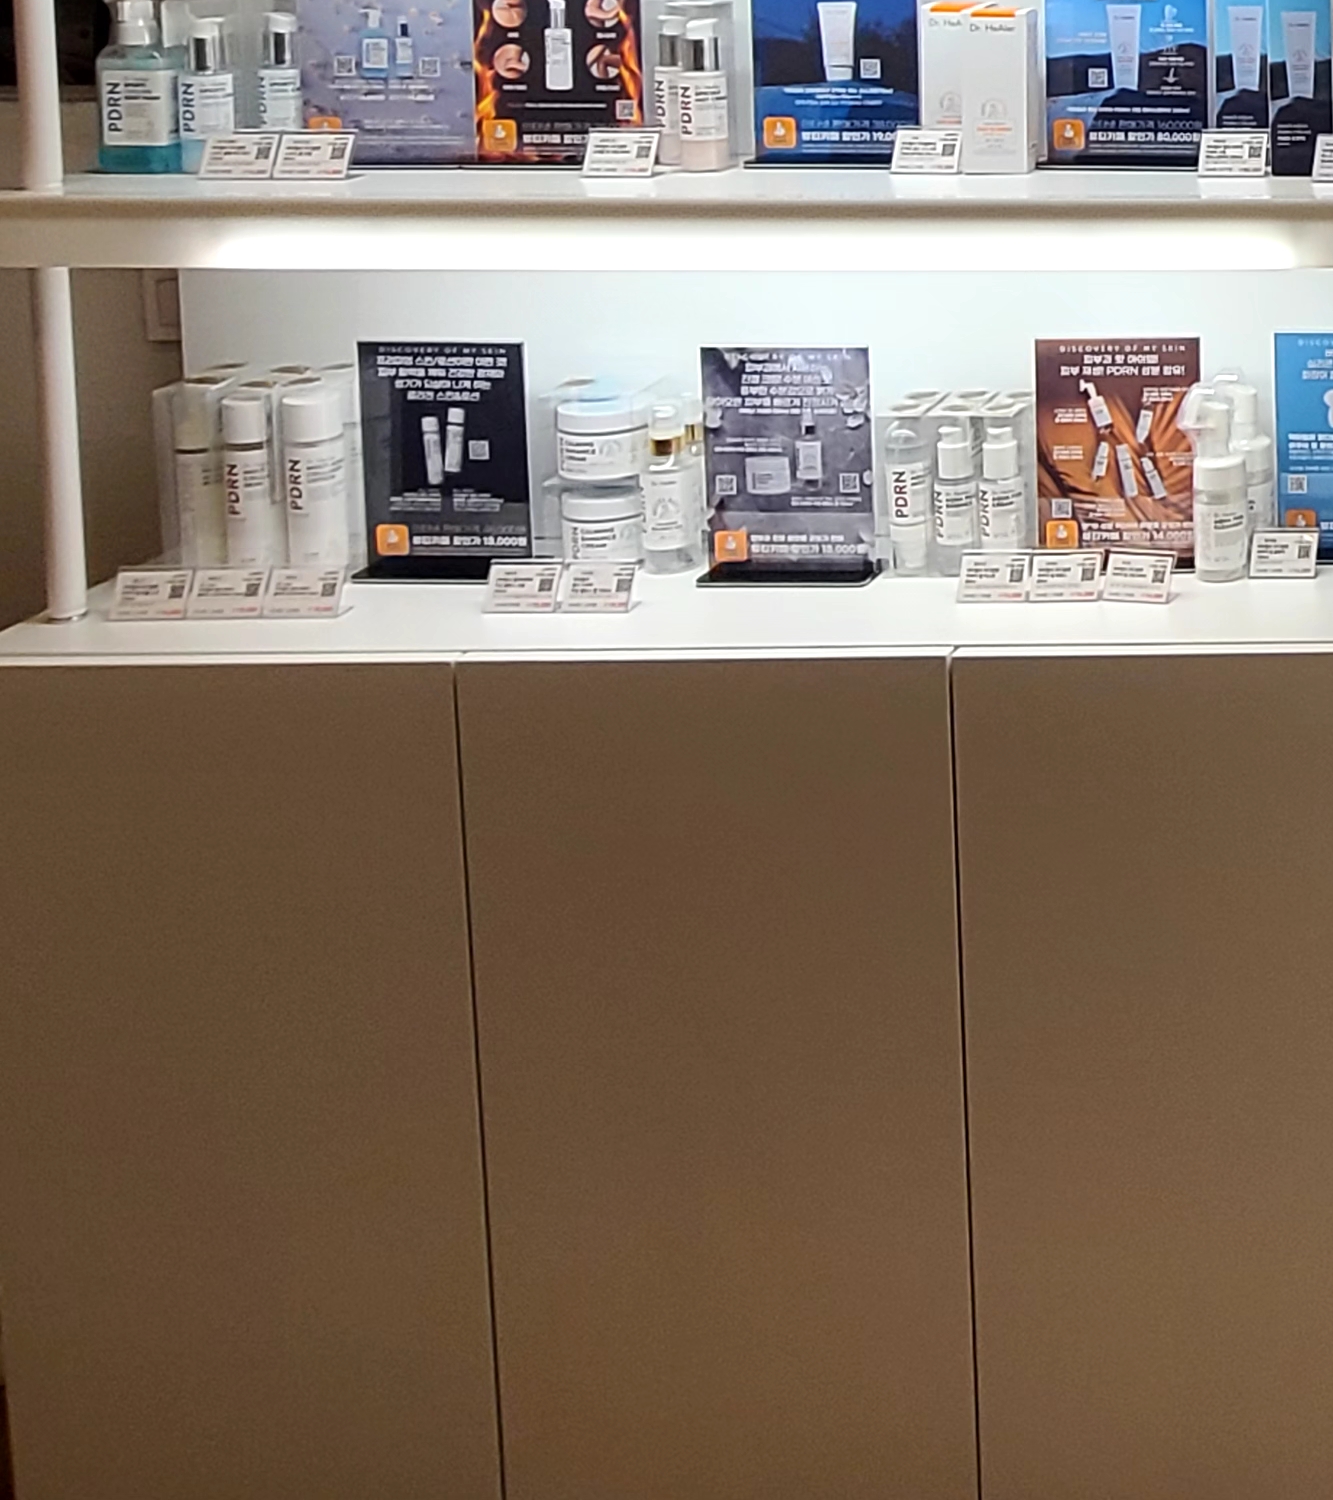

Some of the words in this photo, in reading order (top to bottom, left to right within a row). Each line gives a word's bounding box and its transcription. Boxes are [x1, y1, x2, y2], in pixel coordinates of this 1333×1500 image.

[106, 82, 123, 132] PDRN
[182, 83, 196, 132] PDRN
[680, 86, 693, 135] PDRN
[227, 464, 240, 515] PDRN
[289, 460, 302, 511] PDRN
[893, 471, 908, 518] PDRN
